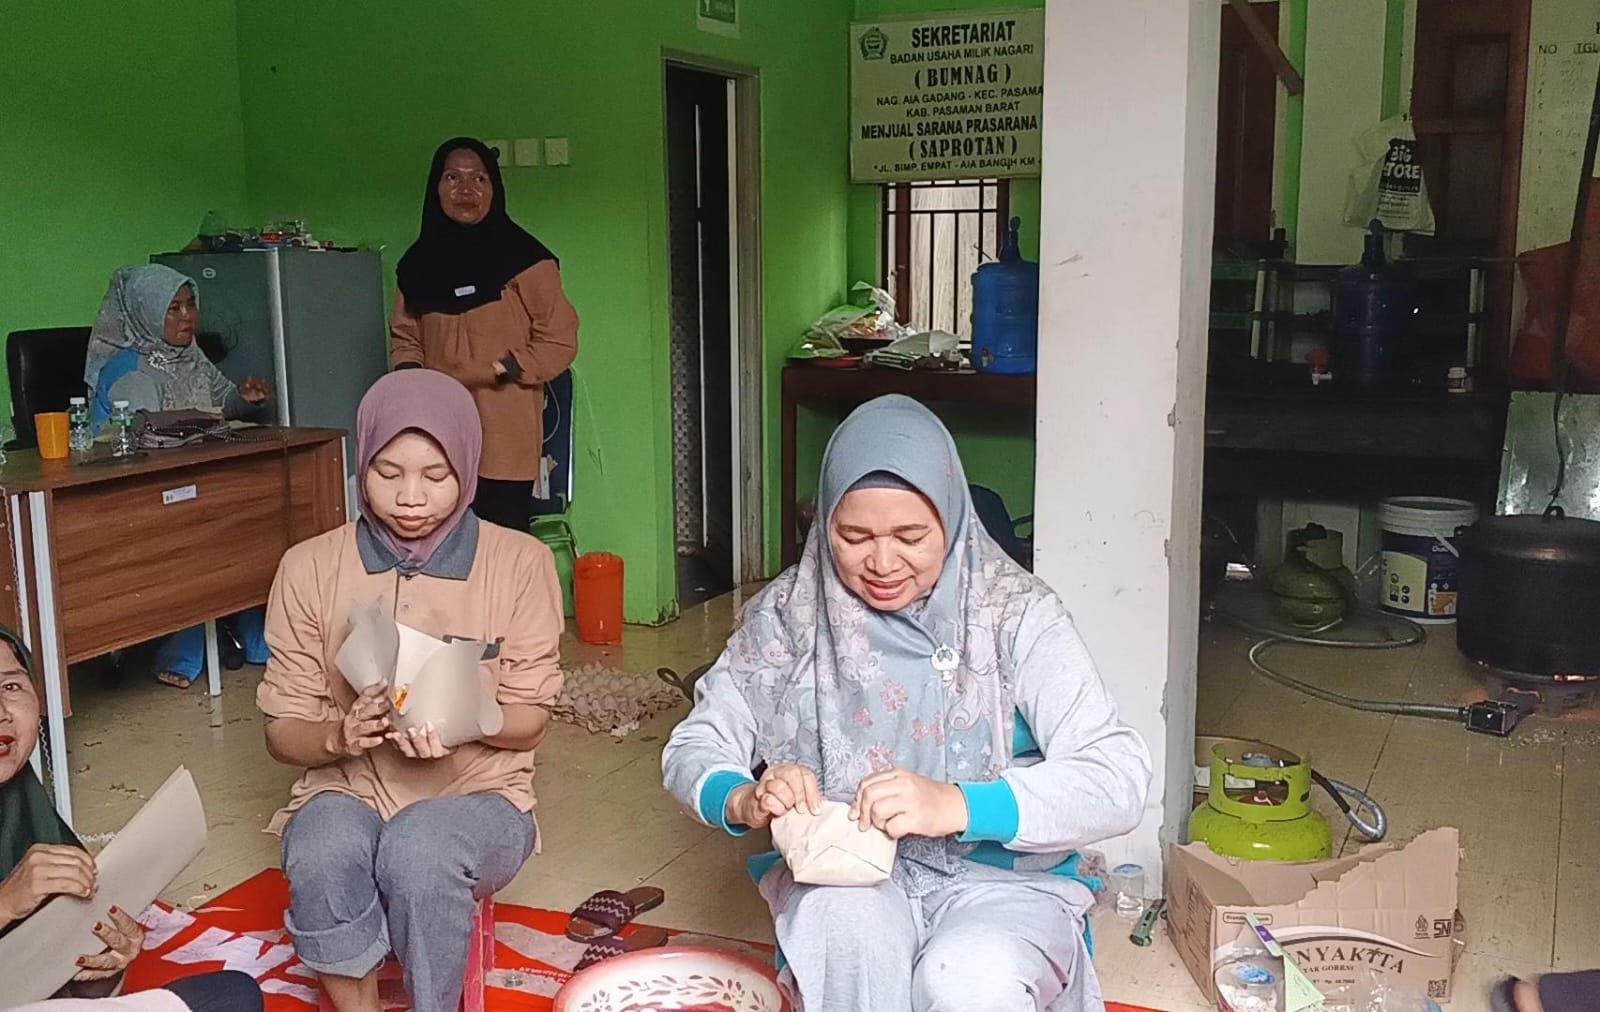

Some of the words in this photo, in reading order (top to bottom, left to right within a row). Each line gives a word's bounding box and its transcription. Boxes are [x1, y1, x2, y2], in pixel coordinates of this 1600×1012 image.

[912, 21, 1015, 48] SEKRETARIAT
[890, 52, 924, 64] BADAN
[927, 50, 961, 62] USAHA
[964, 47, 991, 58] MILIK
[994, 44, 1033, 57] NAGARI
[1538, 44, 1557, 54] NO
[877, 96, 901, 106] NAG.
[904, 95, 919, 105] AIA
[923, 91, 965, 103] GADANG
[974, 89, 997, 100] KEC.
[907, 106, 930, 117] KAB.
[933, 104, 982, 116] PASAMAN
[986, 101, 1020, 113] BARAT
[861, 122, 913, 139] MENJUAL
[916, 120, 962, 136] SARANA
[967, 116, 1037, 134] PRASARANA
[894, 162, 918, 172] SIMP.
[921, 161, 952, 171] EMPAT
[960, 159, 977, 169] AIA
[1020, 156, 1035, 166] KM
[1383, 162, 1420, 179] STORE
